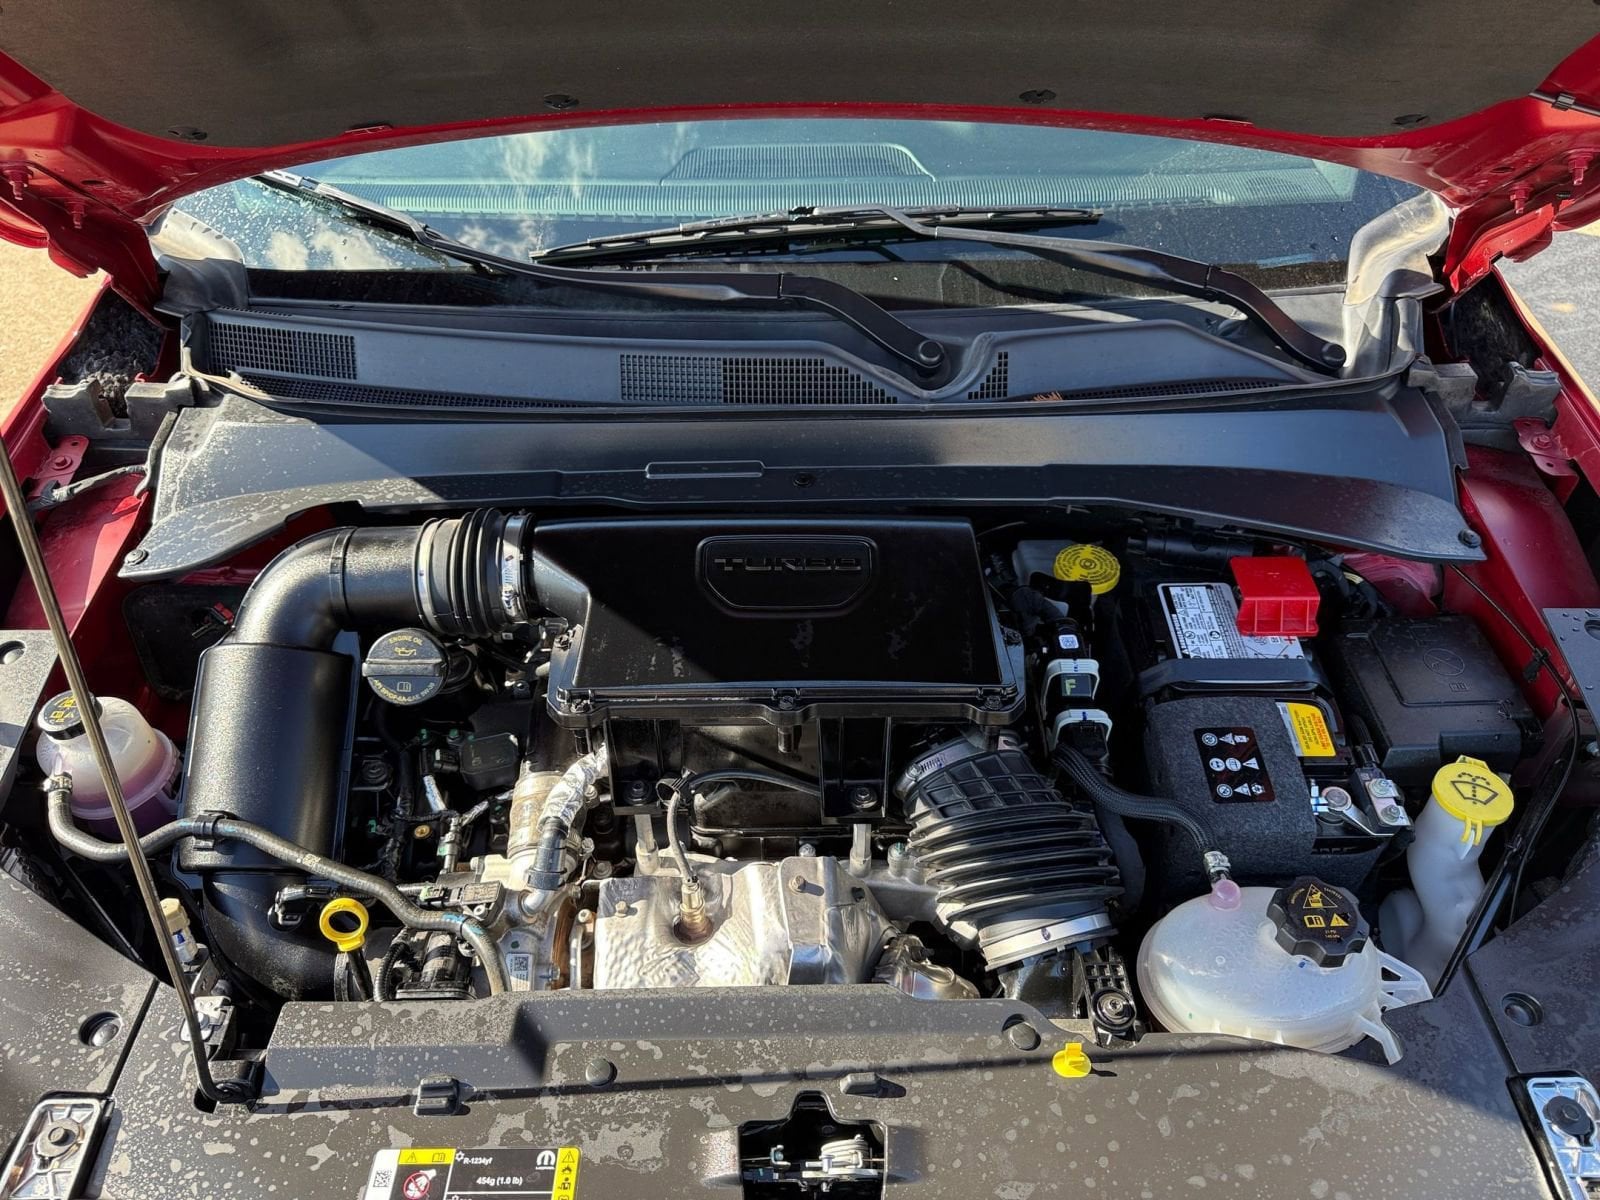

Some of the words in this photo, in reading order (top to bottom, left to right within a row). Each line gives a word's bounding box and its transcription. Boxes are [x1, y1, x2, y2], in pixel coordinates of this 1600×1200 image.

[714, 557, 861, 571] TURBO
[388, 635, 412, 644] ENGINE
[412, 637, 423, 646] OIL
[1065, 679, 1077, 696] F
[463, 1157, 493, 1166] R-1234yf
[476, 1176, 496, 1187] 454g
[496, 1176, 511, 1186] (1.0
[512, 1176, 523, 1186] lb)
